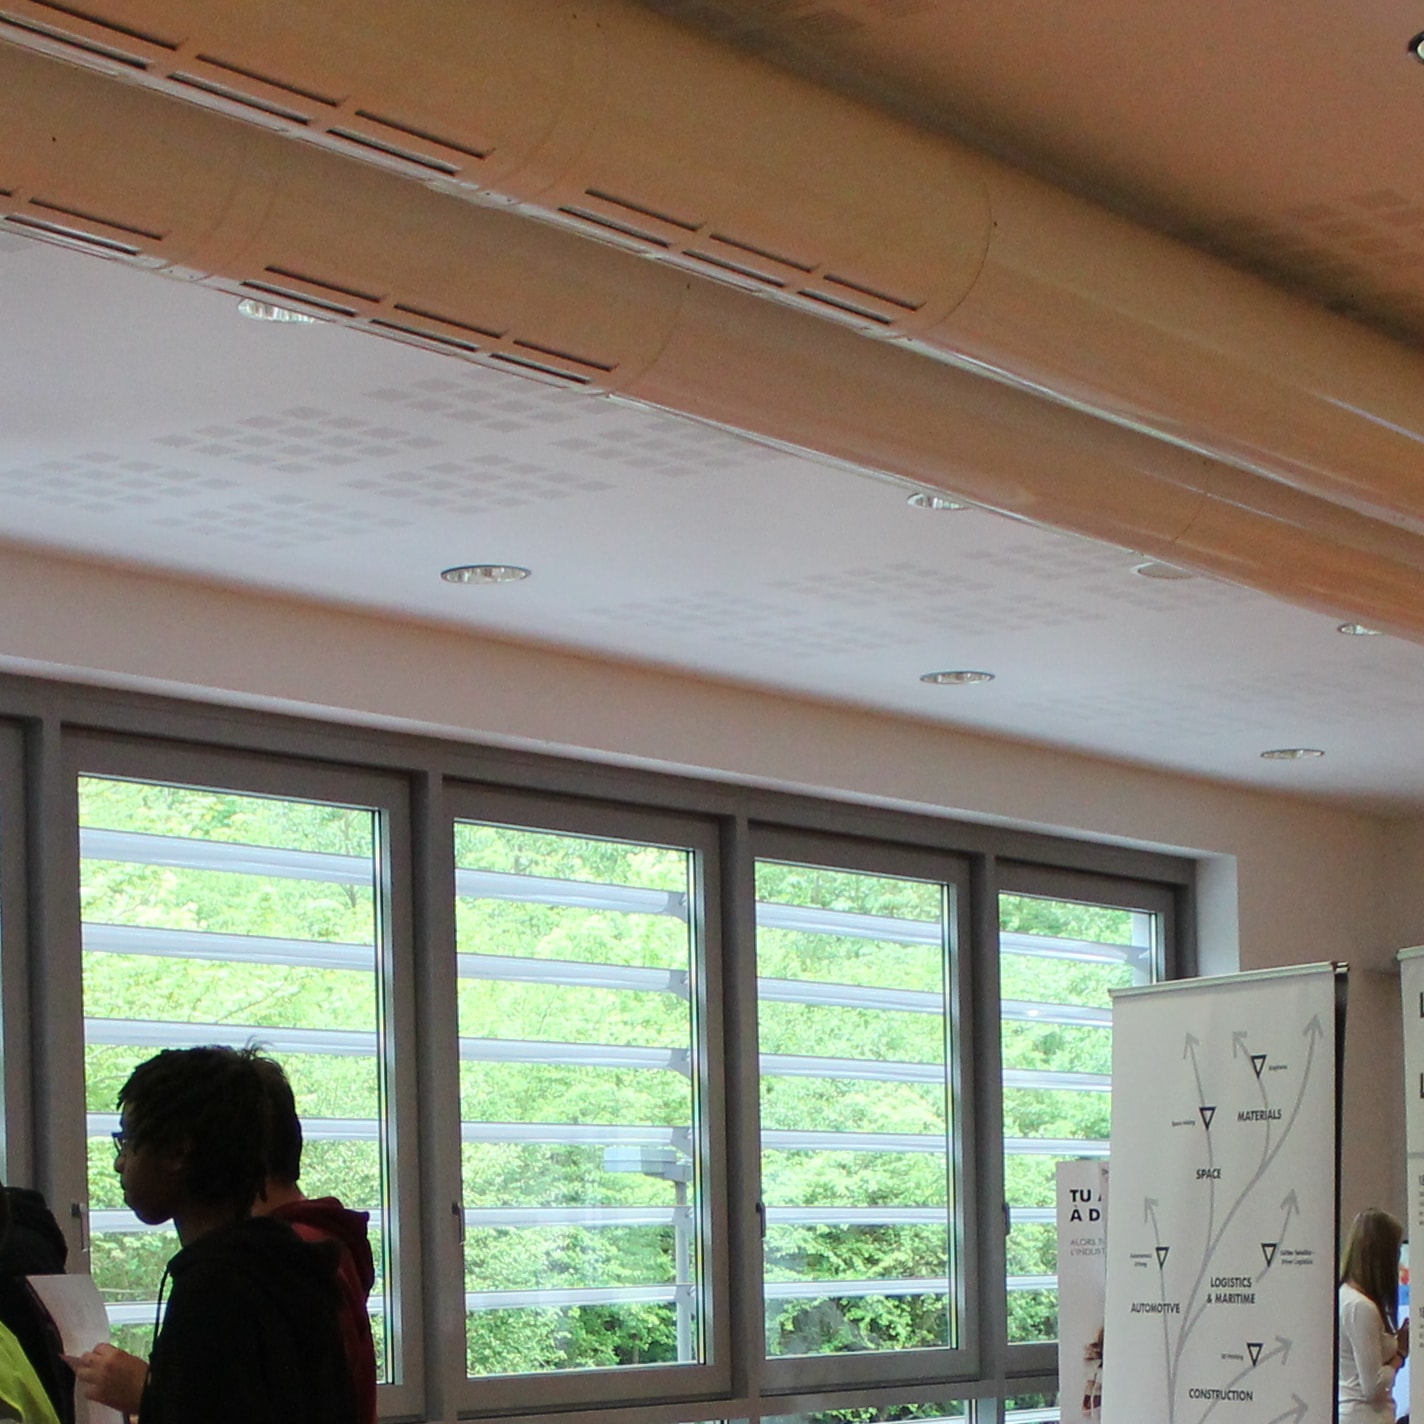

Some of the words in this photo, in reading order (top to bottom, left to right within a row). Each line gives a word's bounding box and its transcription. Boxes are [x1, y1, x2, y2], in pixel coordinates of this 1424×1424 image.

[1237, 1108, 1283, 1123] MATERIALS
[1196, 1167, 1222, 1181] SPACE
[1069, 1188, 1092, 1203] TU
[1210, 1276, 1253, 1289] LOGISTICS
[1206, 1294, 1214, 1304] &
[1215, 1292, 1257, 1305] MARITIME
[1130, 1302, 1181, 1315] AUTOMOTIVE
[1188, 1387, 1254, 1402] CONSTRUCTION
